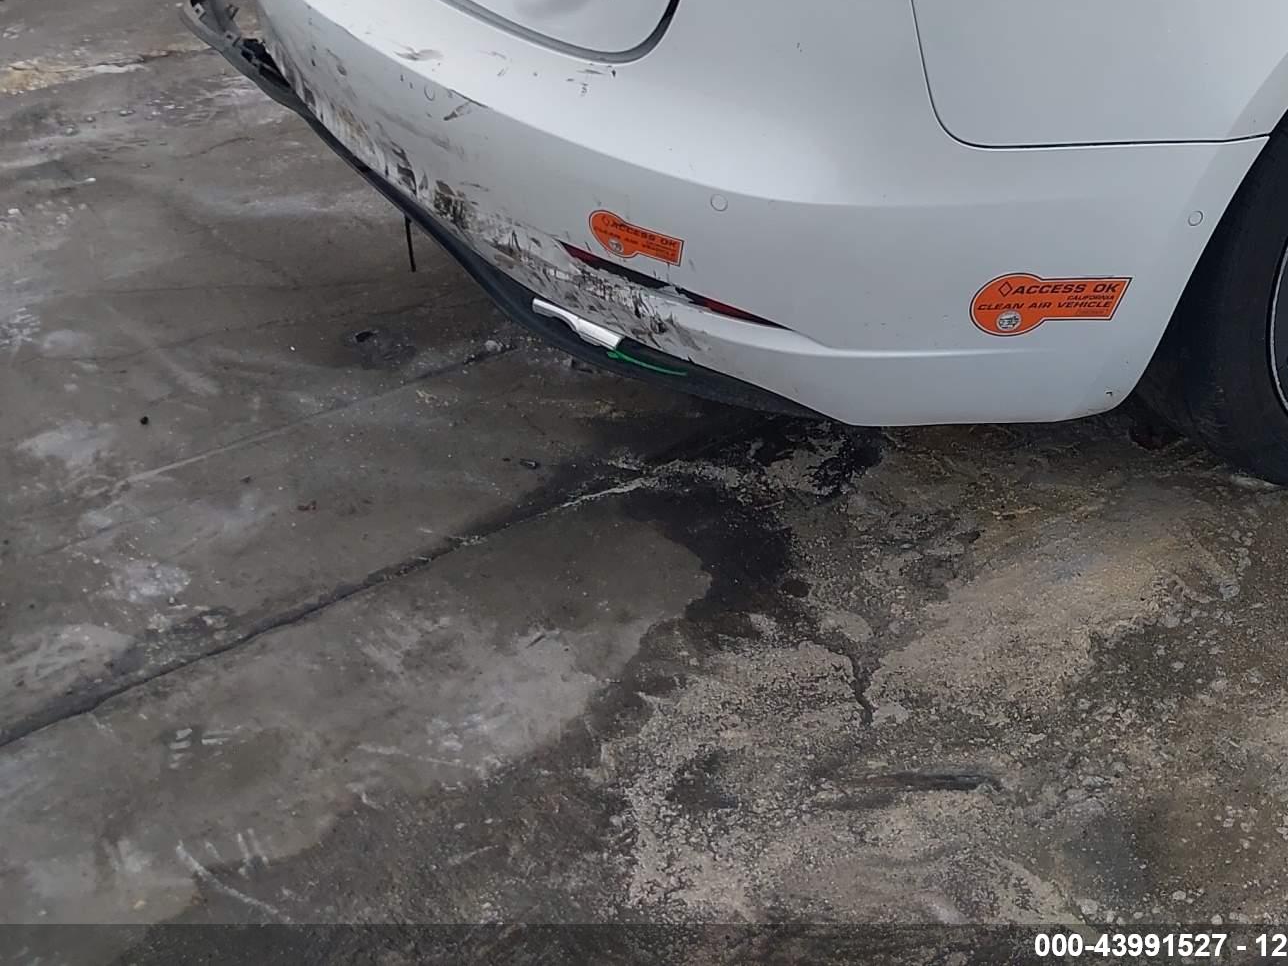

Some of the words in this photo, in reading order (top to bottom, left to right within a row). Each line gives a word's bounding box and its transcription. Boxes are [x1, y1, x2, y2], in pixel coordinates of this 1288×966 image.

[1012, 284, 1086, 294] ACCESS
[1093, 283, 1121, 293] OK
[977, 302, 1024, 311] CLEAN
[1028, 301, 1052, 309] AIR
